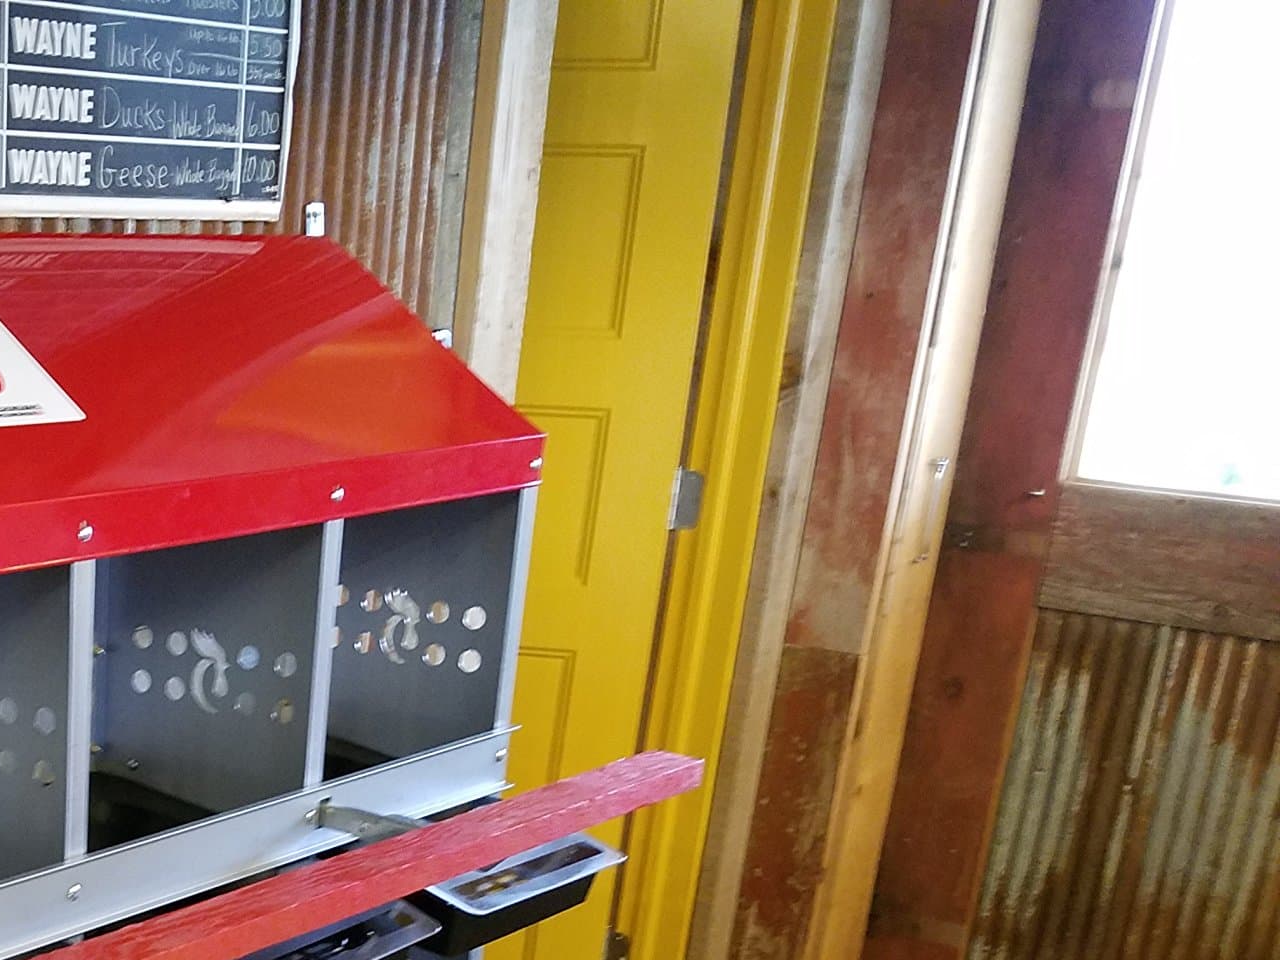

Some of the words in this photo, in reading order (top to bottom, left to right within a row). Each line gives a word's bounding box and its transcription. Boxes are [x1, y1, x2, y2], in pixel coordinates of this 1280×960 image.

[11, 16, 97, 60] WAYNE
[9, 83, 94, 124] WAYNE
[9, 148, 92, 187] WAYNE
